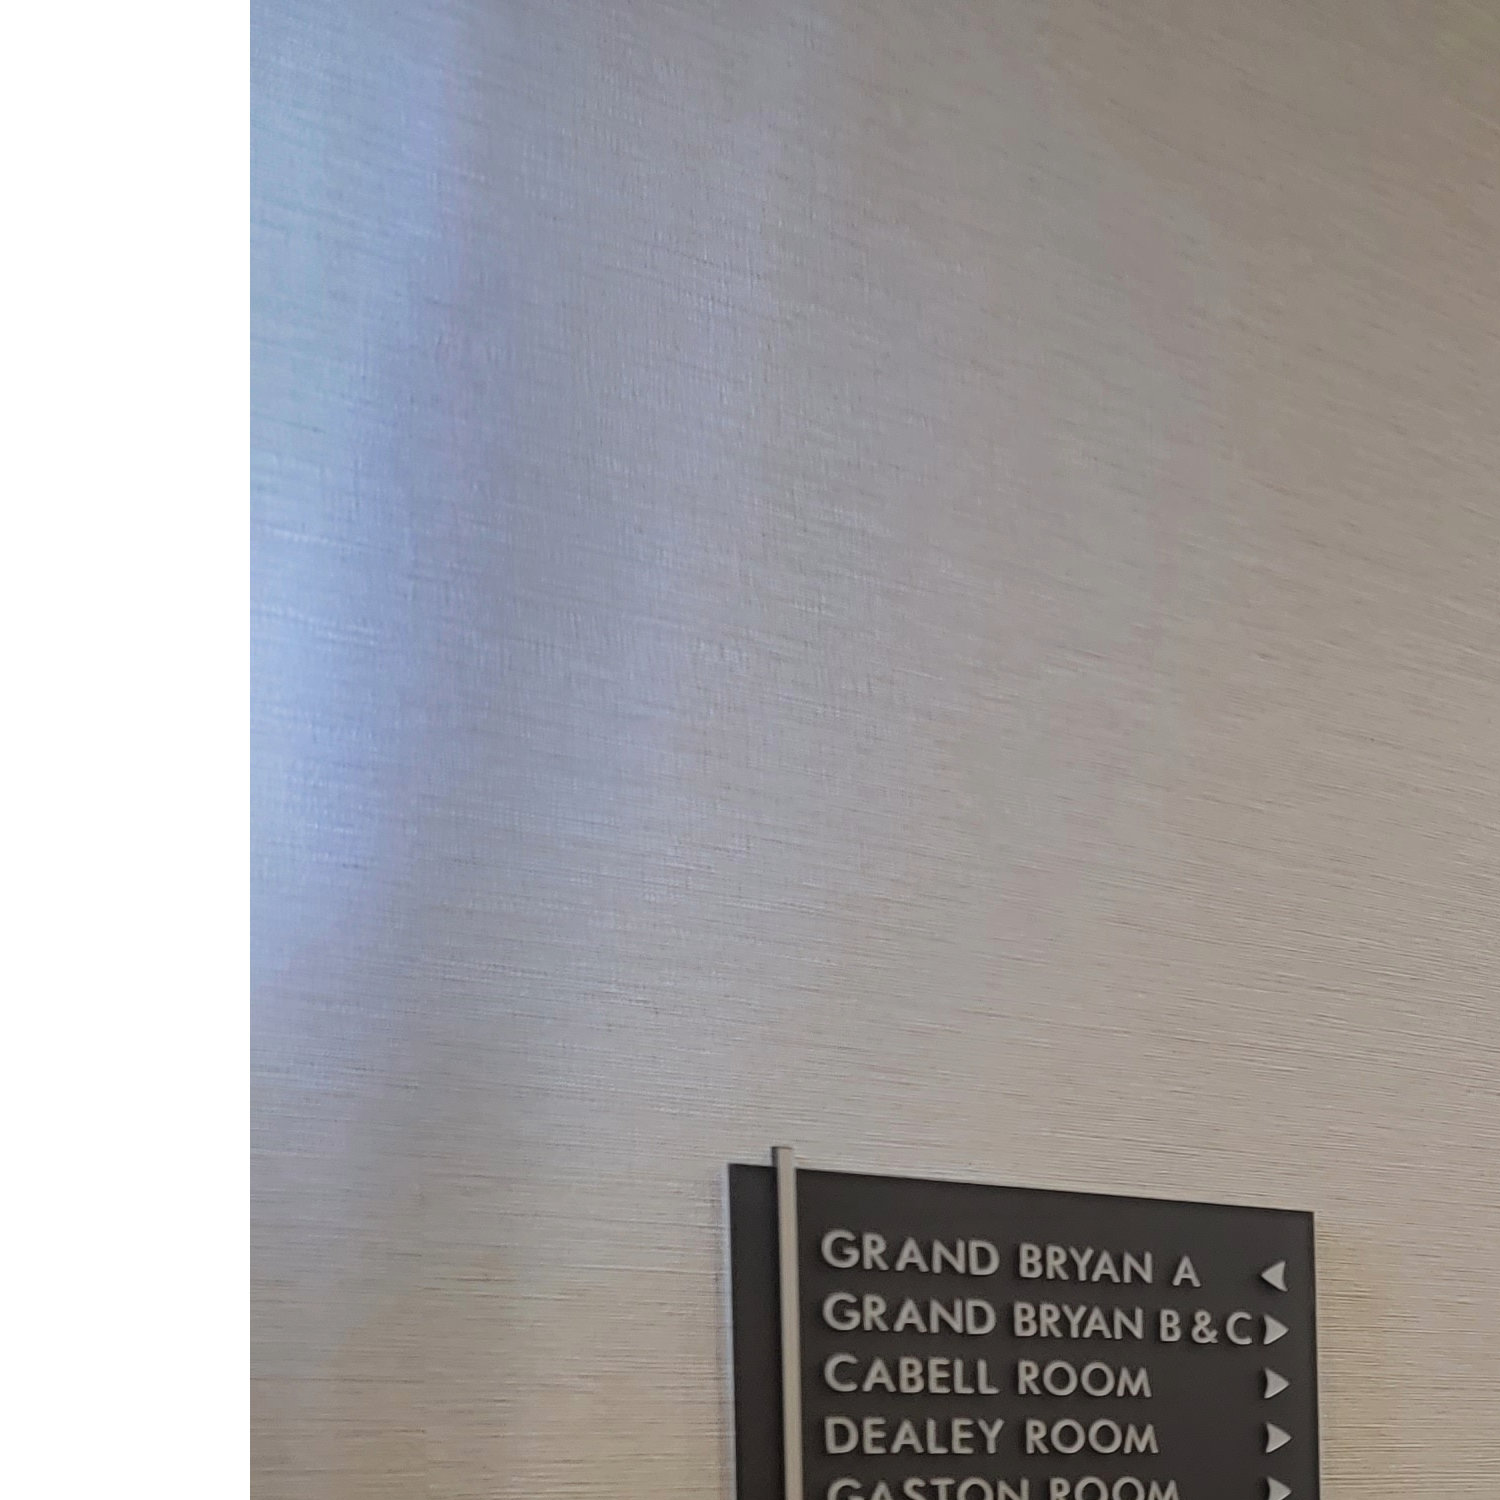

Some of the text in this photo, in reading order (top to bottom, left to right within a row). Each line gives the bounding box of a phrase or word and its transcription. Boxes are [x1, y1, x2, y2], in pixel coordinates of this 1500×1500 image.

[821, 1229, 1201, 1288] GRAND BRYAN A
[823, 1292, 996, 1335] GRAND
[1013, 1301, 1143, 1340] BRYAN
[824, 1353, 1152, 1398] CABELL ROOM
[825, 1416, 1159, 1454] DEALEY ROOM
